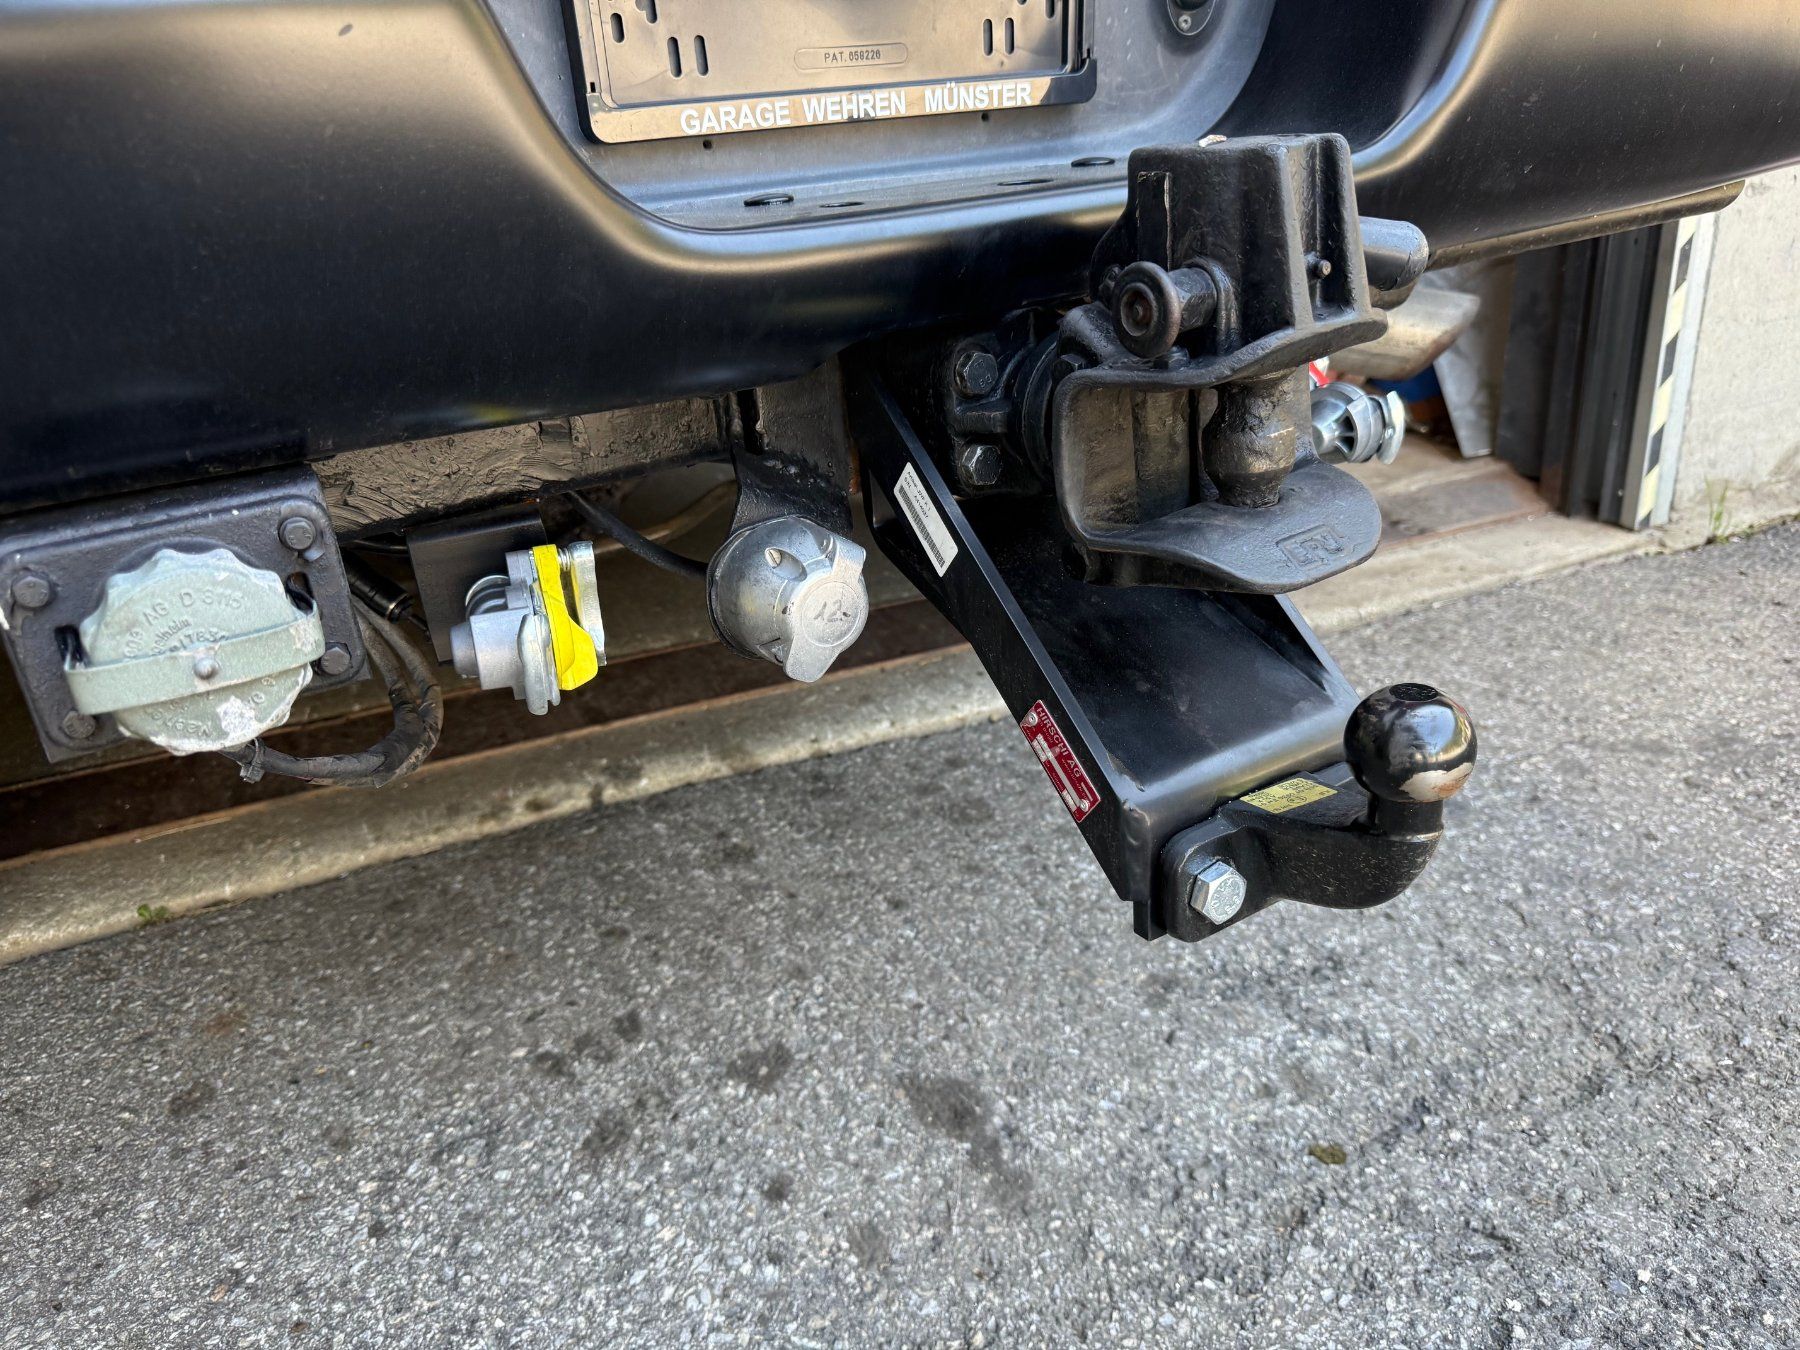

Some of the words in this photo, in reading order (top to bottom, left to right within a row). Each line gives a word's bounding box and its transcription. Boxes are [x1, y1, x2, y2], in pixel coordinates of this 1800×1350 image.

[680, 100, 791, 134] GARAGE
[802, 91, 905, 122] WEHREN
[924, 81, 1032, 112] MÜNSTER
[1036, 707, 1070, 756] HIRSCHI
[1067, 759, 1082, 778] AG
